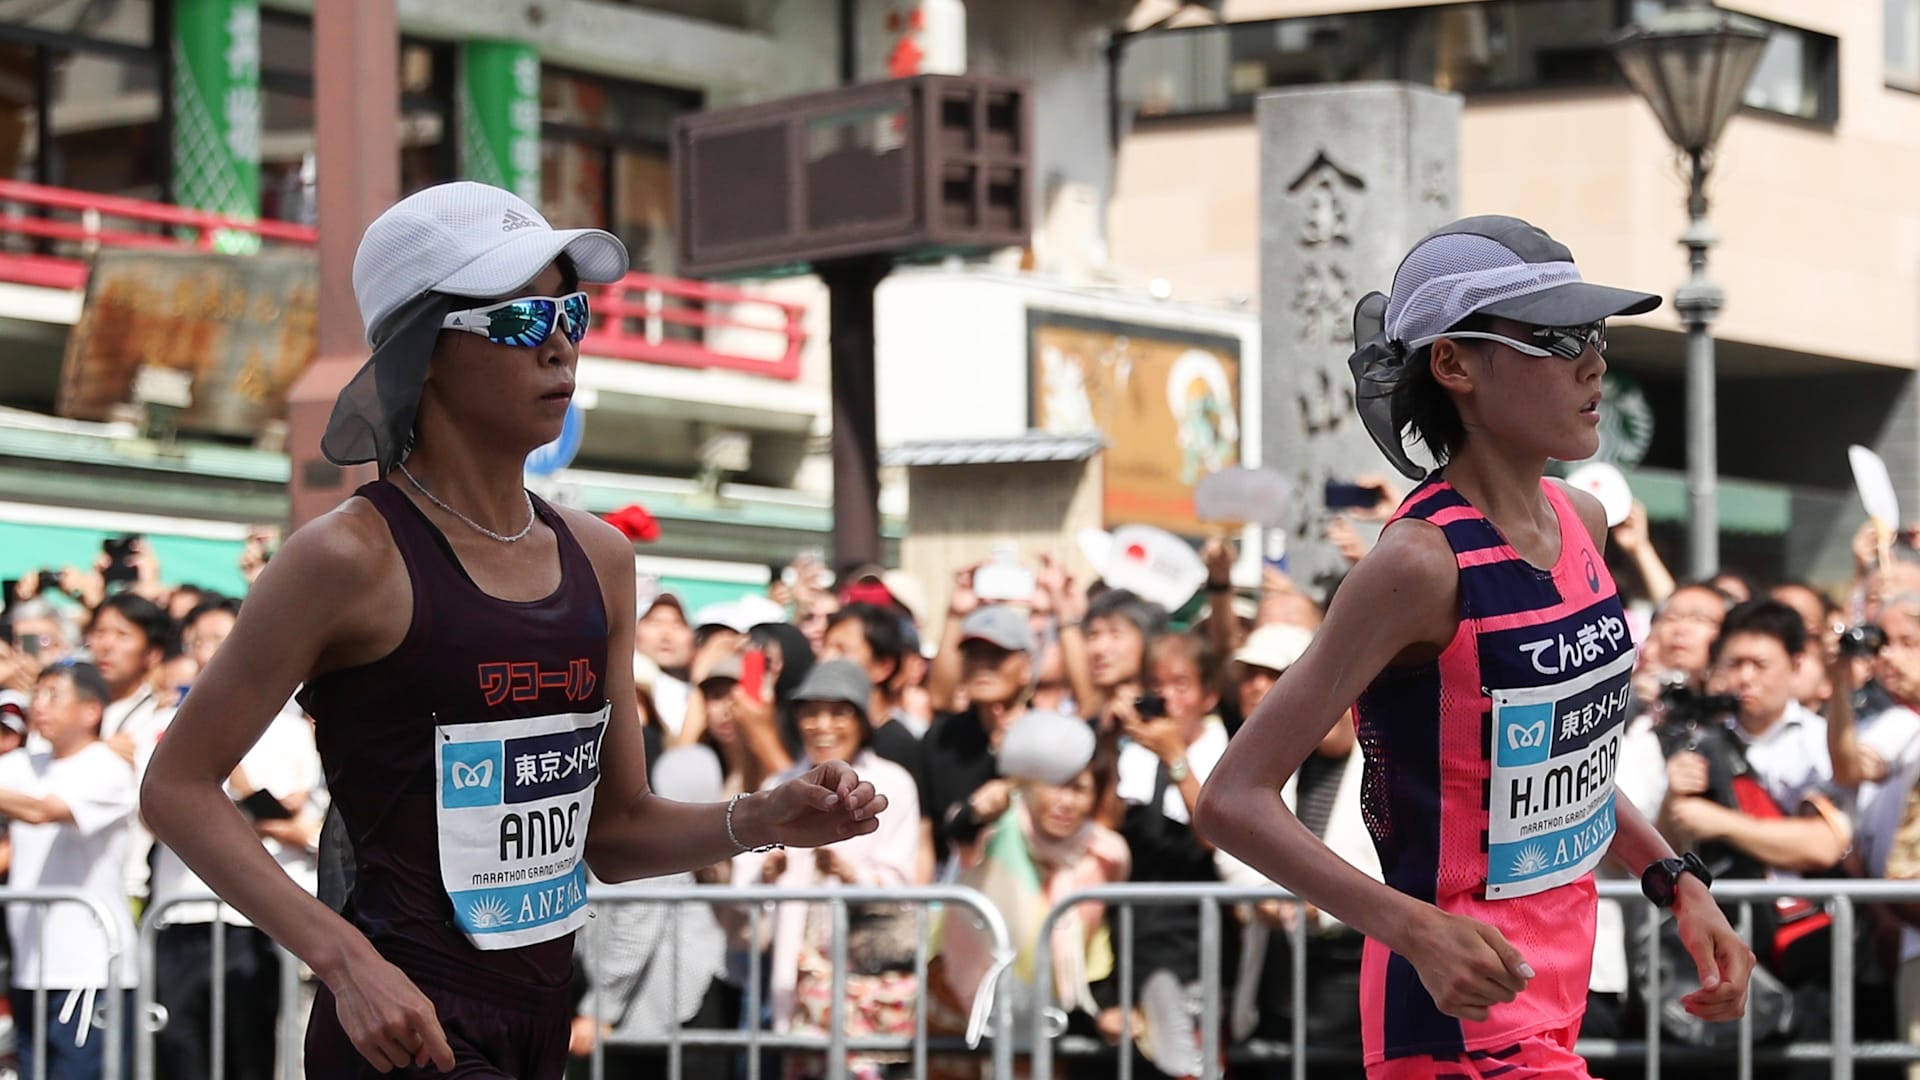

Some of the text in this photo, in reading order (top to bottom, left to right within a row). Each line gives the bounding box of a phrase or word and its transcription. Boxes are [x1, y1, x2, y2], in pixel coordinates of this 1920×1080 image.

[1519, 615, 1624, 674] てんまや
[478, 659, 597, 706] ワコール
[1558, 682, 1629, 741] 東京メトロ
[514, 740, 597, 787] 東京メトロ
[1510, 735, 1618, 820] H.MAEDA
[1520, 815, 1563, 838] MARATHON
[1552, 807, 1611, 866] ANESSA
[472, 868, 526, 886] MARATHON
[527, 863, 554, 879] GRAND
